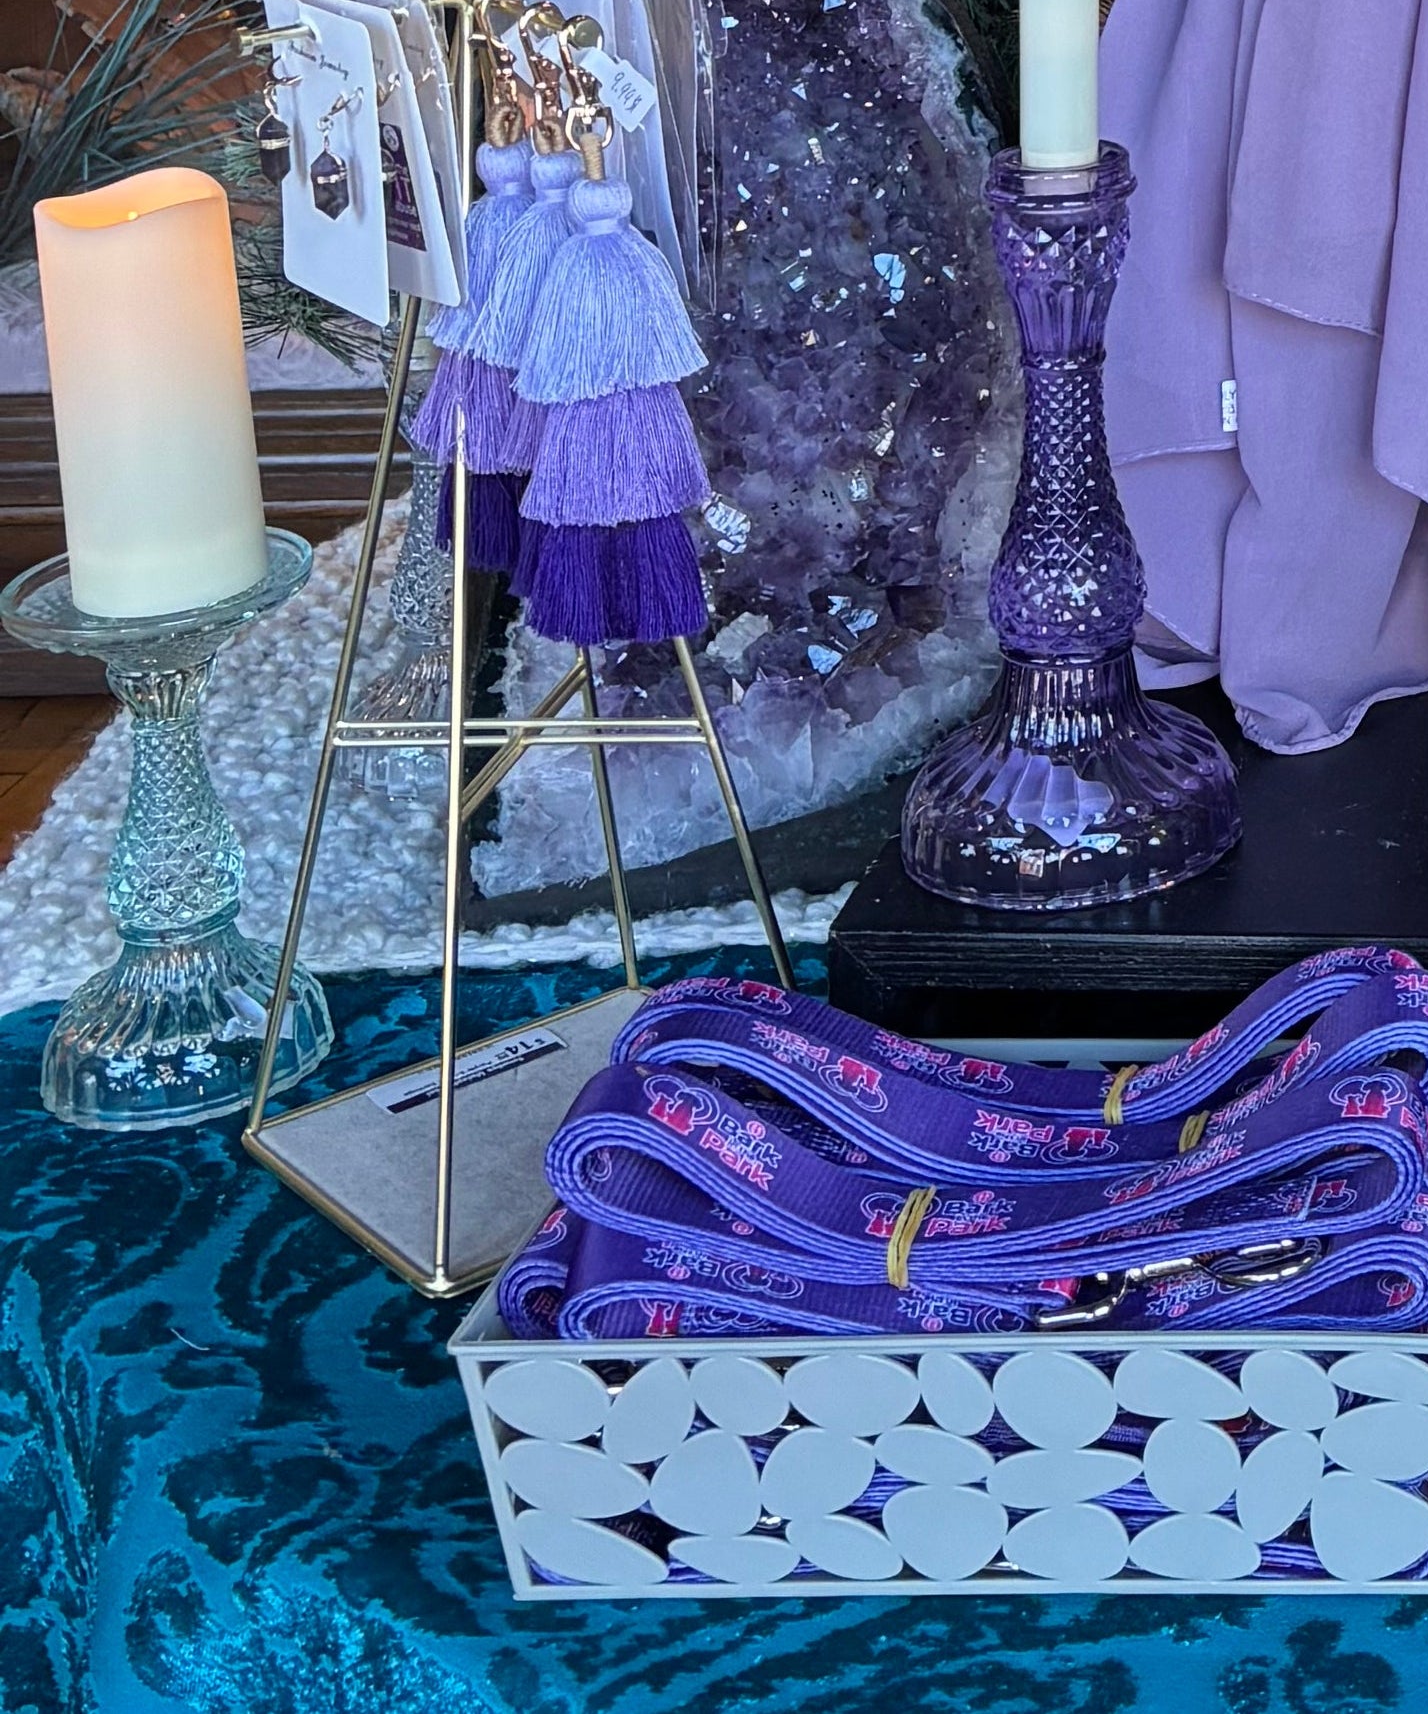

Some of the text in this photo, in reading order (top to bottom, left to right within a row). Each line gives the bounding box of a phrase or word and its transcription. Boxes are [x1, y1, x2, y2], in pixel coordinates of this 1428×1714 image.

[718, 1114, 782, 1167] Bark
[968, 1132, 1040, 1157] Bark
[943, 1199, 1016, 1216] Bark
